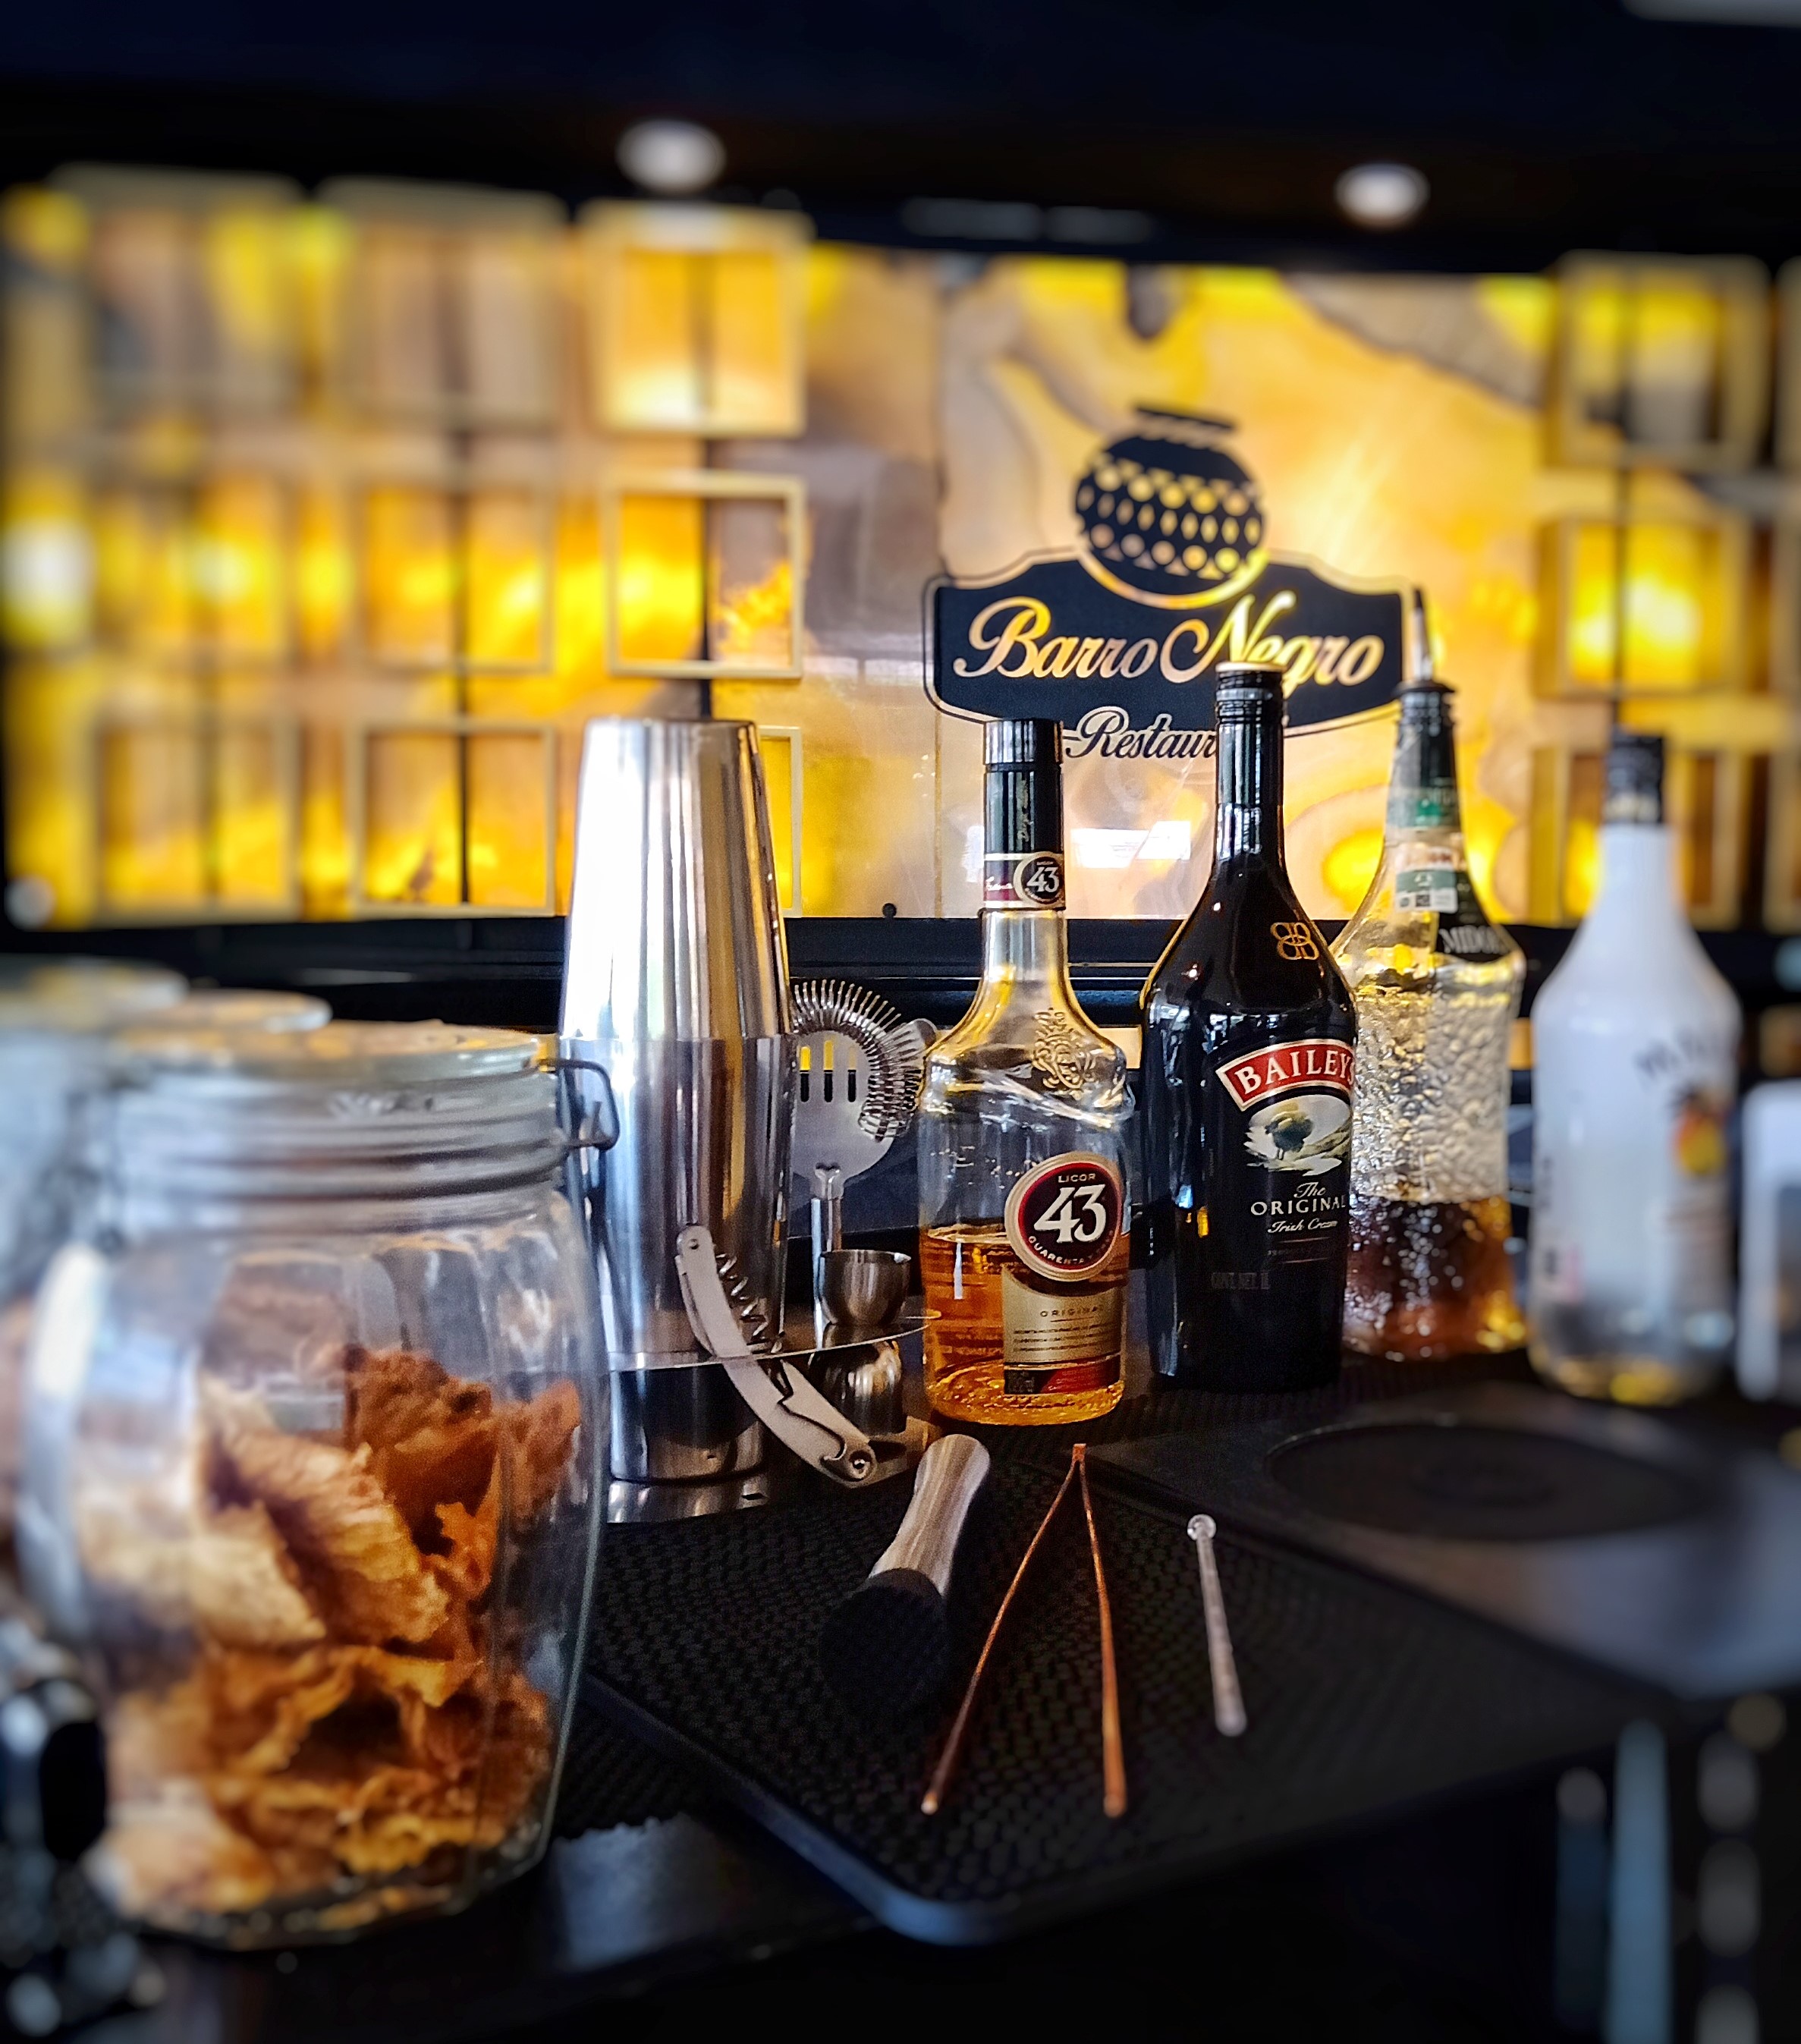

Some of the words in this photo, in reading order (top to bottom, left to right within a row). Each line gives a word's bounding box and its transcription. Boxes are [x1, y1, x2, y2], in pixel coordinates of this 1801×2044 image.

[953, 596, 1158, 678] Barro
[1160, 590, 1385, 699] Negro
[1026, 866, 1060, 893] 43
[1234, 1049, 1356, 1095] BAILEYS
[1058, 1173, 1096, 1183] LICOR
[1293, 1181, 1326, 1199] The
[1033, 1184, 1107, 1244] 43
[1250, 1195, 1347, 1215] ORIGINAL
[1267, 1219, 1304, 1234] Irish
